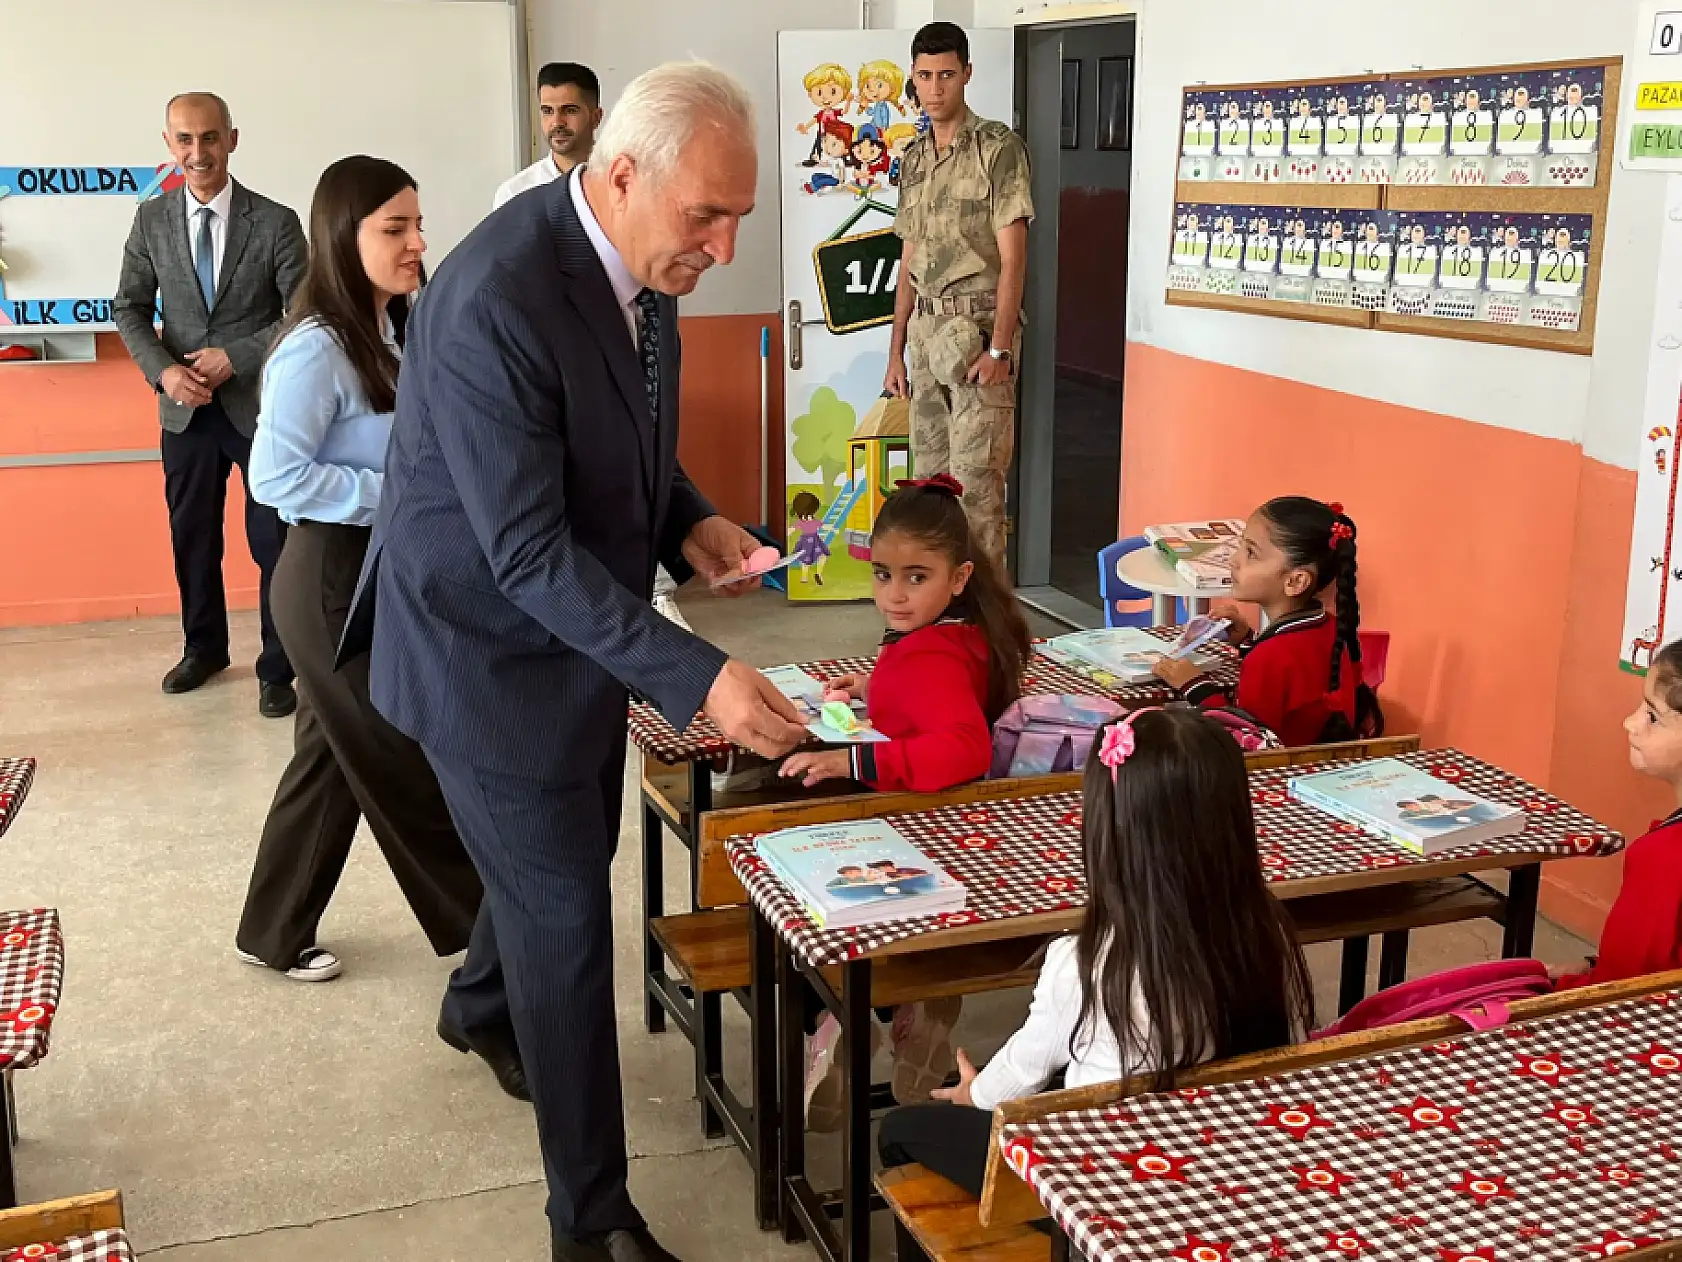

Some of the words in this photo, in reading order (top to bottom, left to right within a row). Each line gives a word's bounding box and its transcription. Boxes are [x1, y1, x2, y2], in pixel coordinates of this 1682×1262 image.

[1660, 24, 1674, 48] 0
[1642, 86, 1682, 103] PAZA
[1229, 119, 1239, 145] 2
[1262, 119, 1272, 145] 3
[1299, 116, 1311, 144] 4
[1337, 116, 1347, 144] 5
[1373, 116, 1383, 142] 6
[1418, 113, 1431, 143] 7
[1464, 112, 1477, 142] 8
[1513, 110, 1526, 141] 9
[1560, 107, 1587, 140] 10
[17, 168, 138, 194] OKULDA
[1183, 232, 1197, 256] 11
[1219, 233, 1236, 258] 12
[1255, 236, 1270, 261] 13
[1290, 239, 1307, 265] 14
[1327, 240, 1344, 267] 15
[1362, 243, 1380, 270] 16
[1405, 246, 1427, 274] 17
[1451, 248, 1472, 277] 18
[1500, 248, 1521, 279] 19
[1544, 250, 1576, 283] 20
[13, 300, 60, 325] İLK
